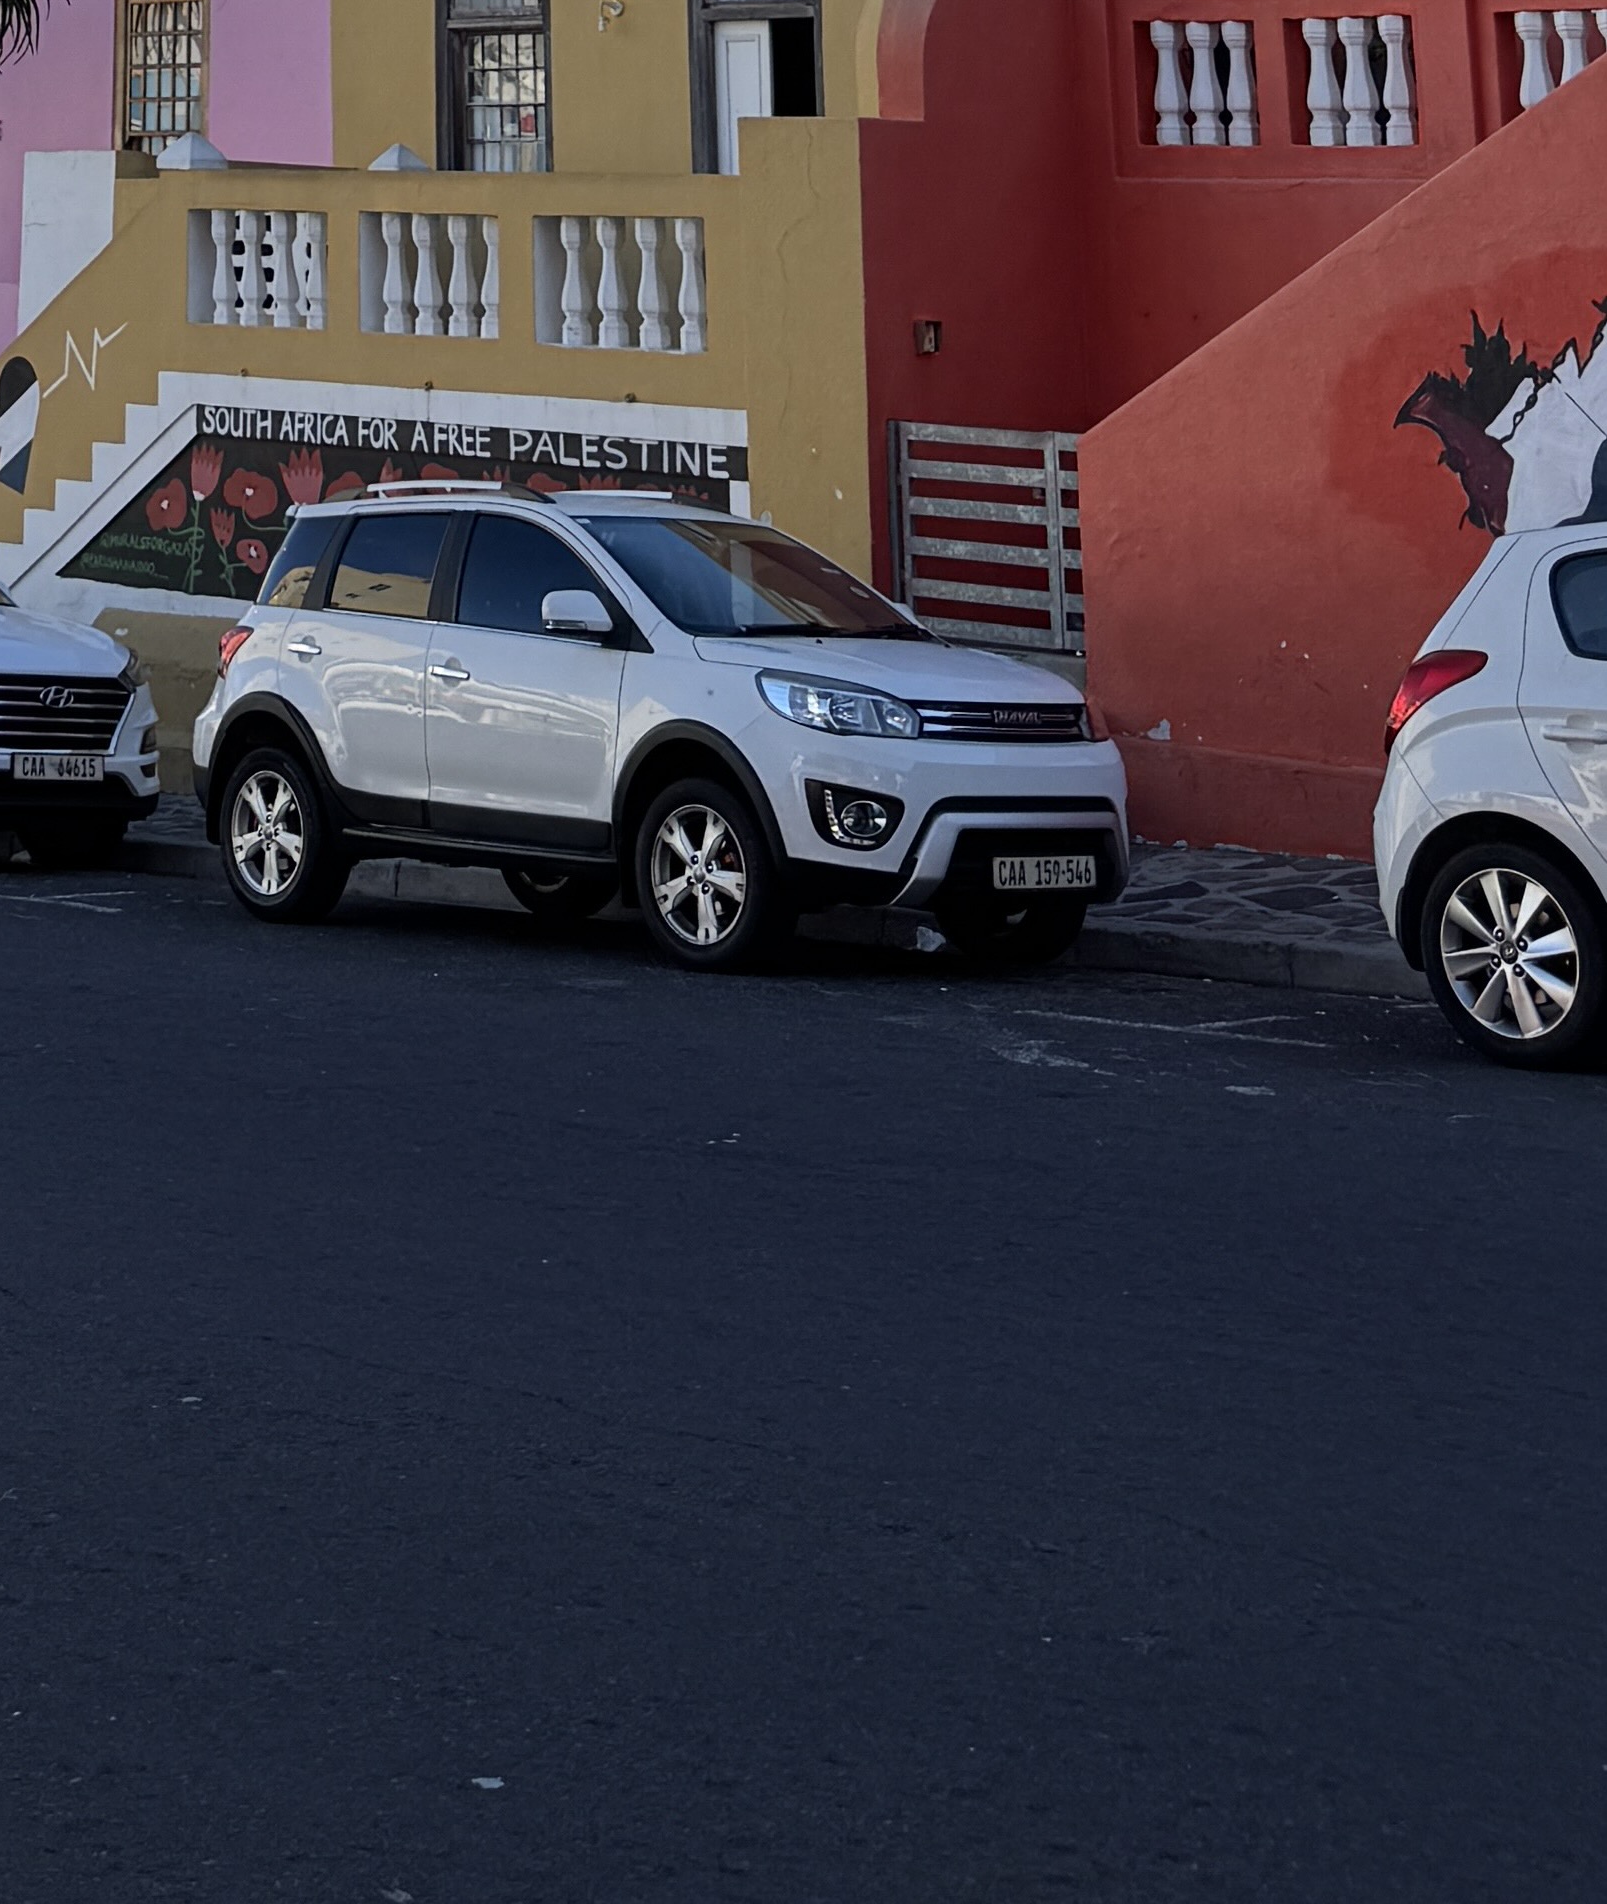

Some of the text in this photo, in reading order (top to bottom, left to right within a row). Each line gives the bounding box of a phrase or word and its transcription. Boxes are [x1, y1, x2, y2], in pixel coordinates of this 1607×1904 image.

[202, 405, 730, 480] SOUTH AFRICA FOR A FREE PALESTINE
[22, 756, 45, 777] CAA
[998, 860, 1026, 886] CAA
